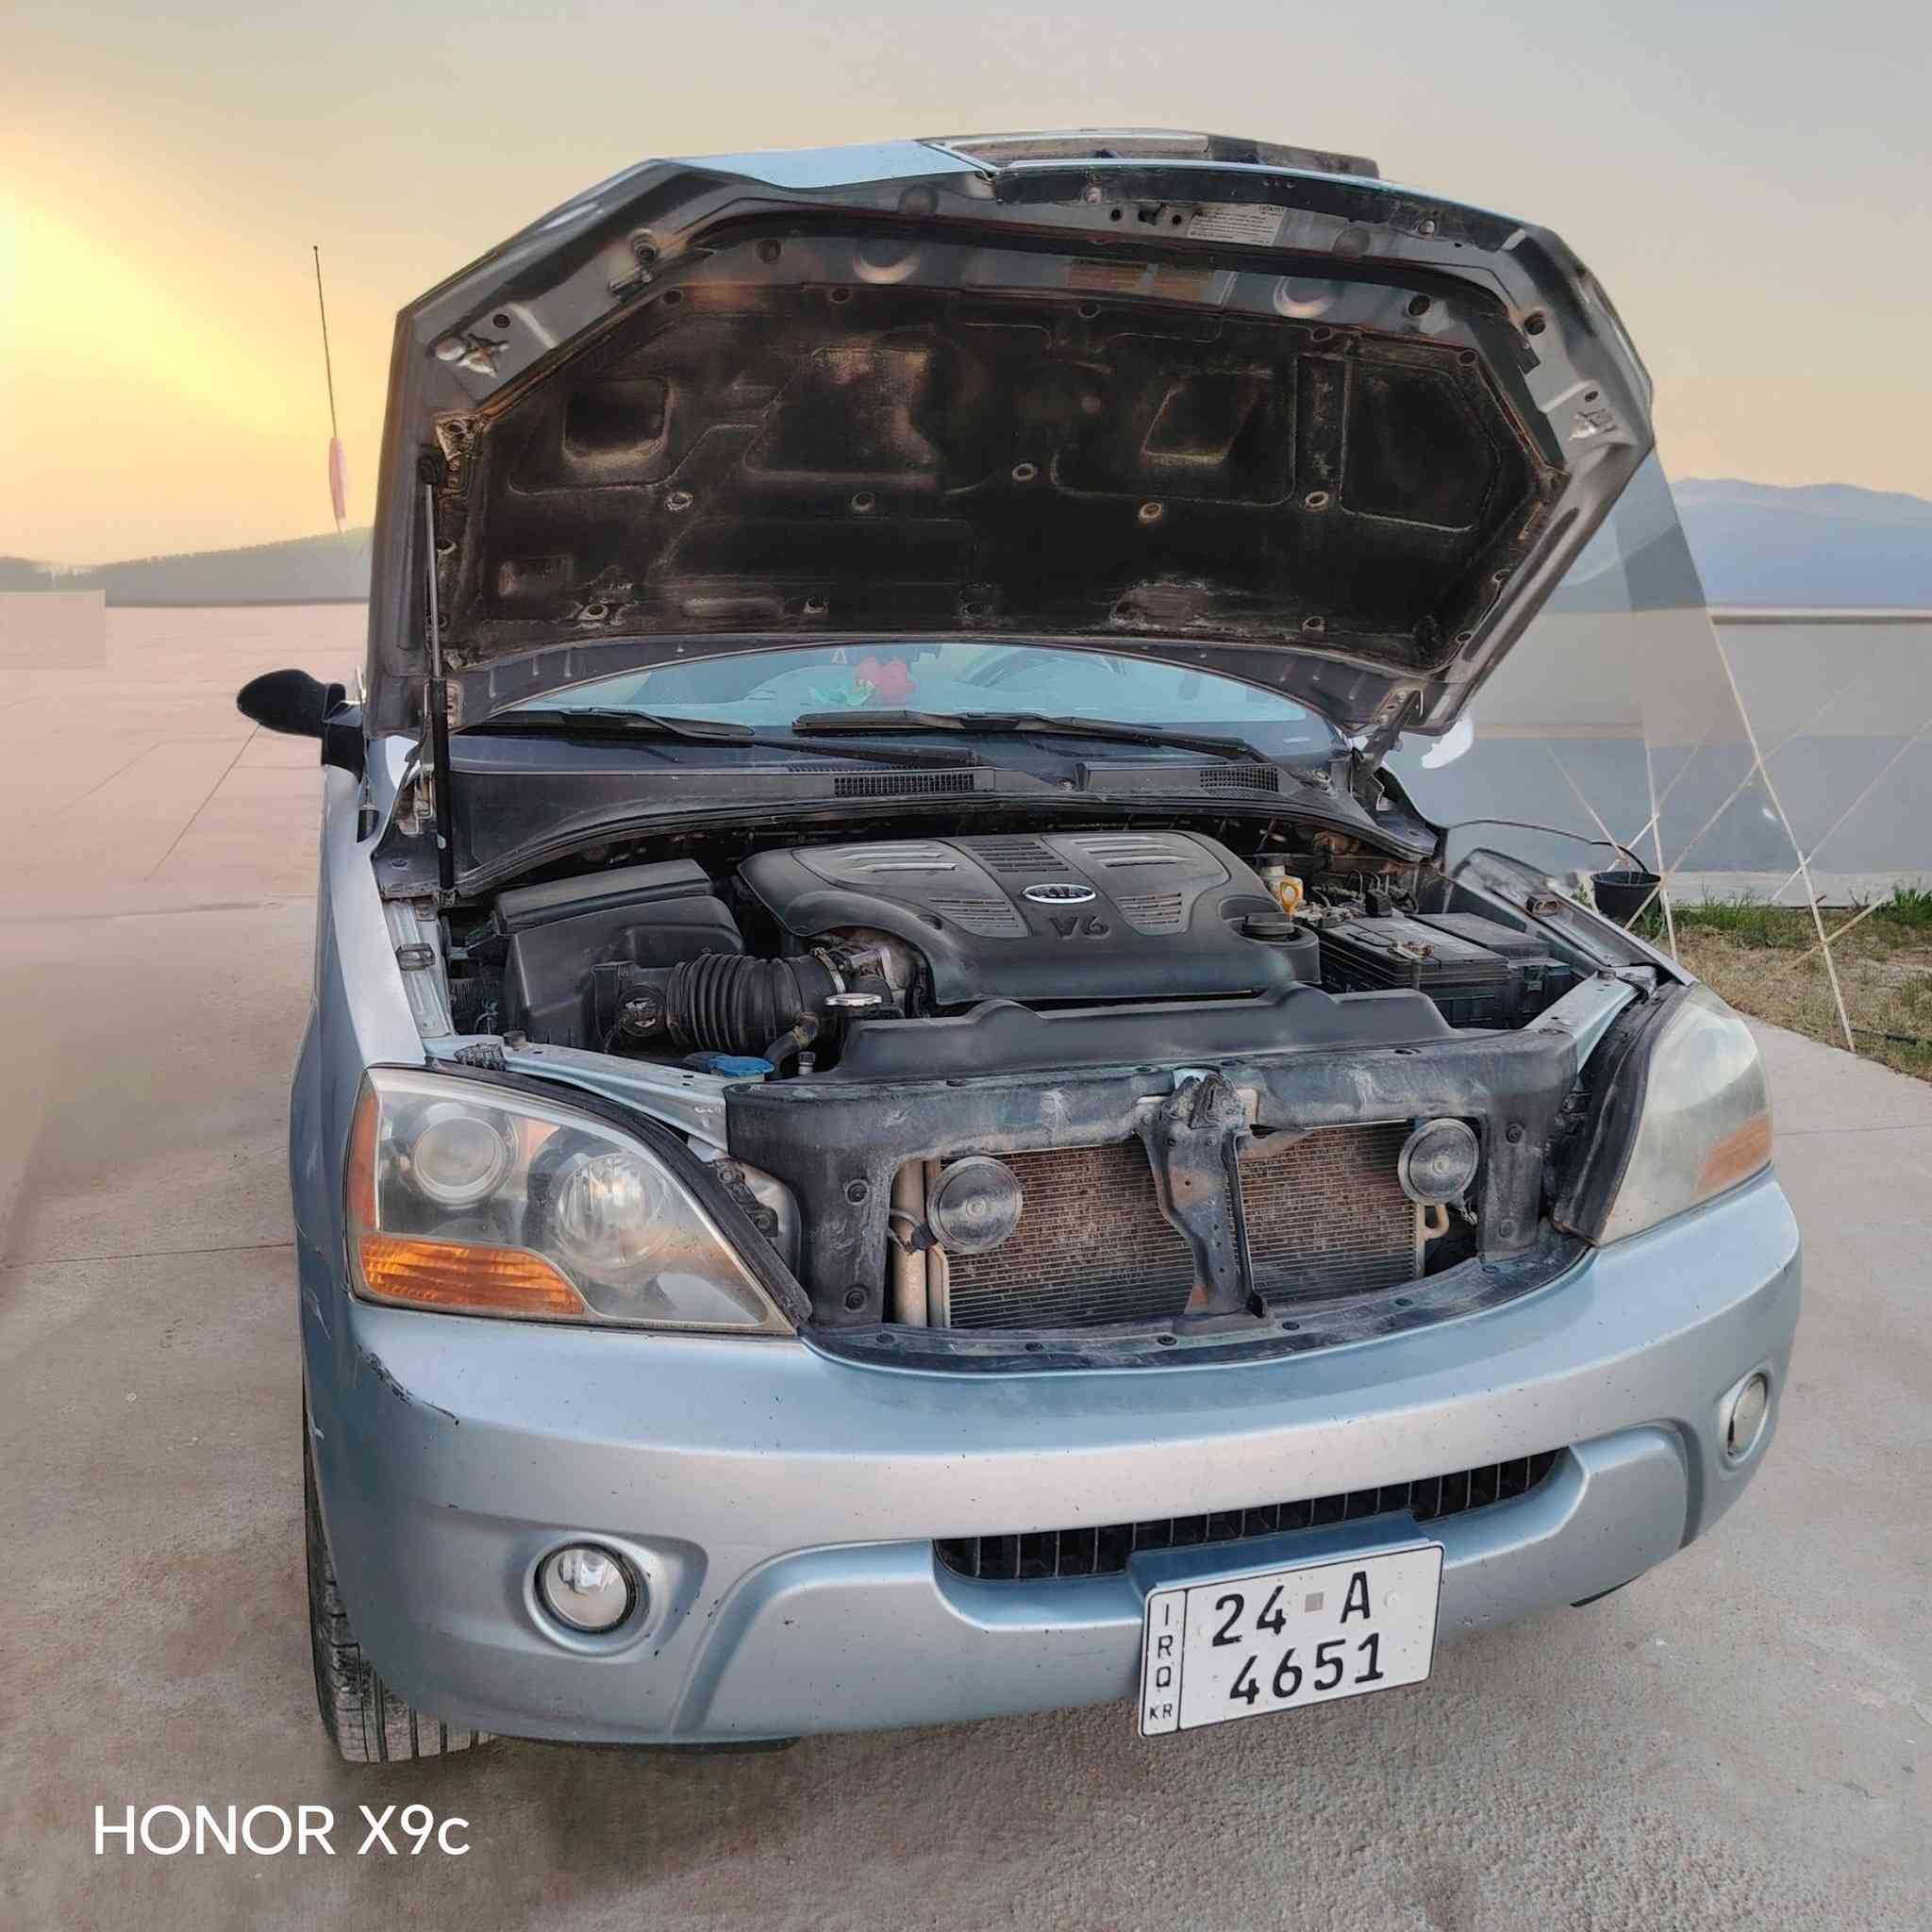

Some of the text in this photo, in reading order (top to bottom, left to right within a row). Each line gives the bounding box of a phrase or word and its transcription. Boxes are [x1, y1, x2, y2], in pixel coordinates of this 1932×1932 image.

[1049, 914, 1109, 940] V6
[1212, 1570, 1371, 1647] 24 A
[1229, 1632, 1384, 1705] 4651
[1149, 1703, 1173, 1720] KR
